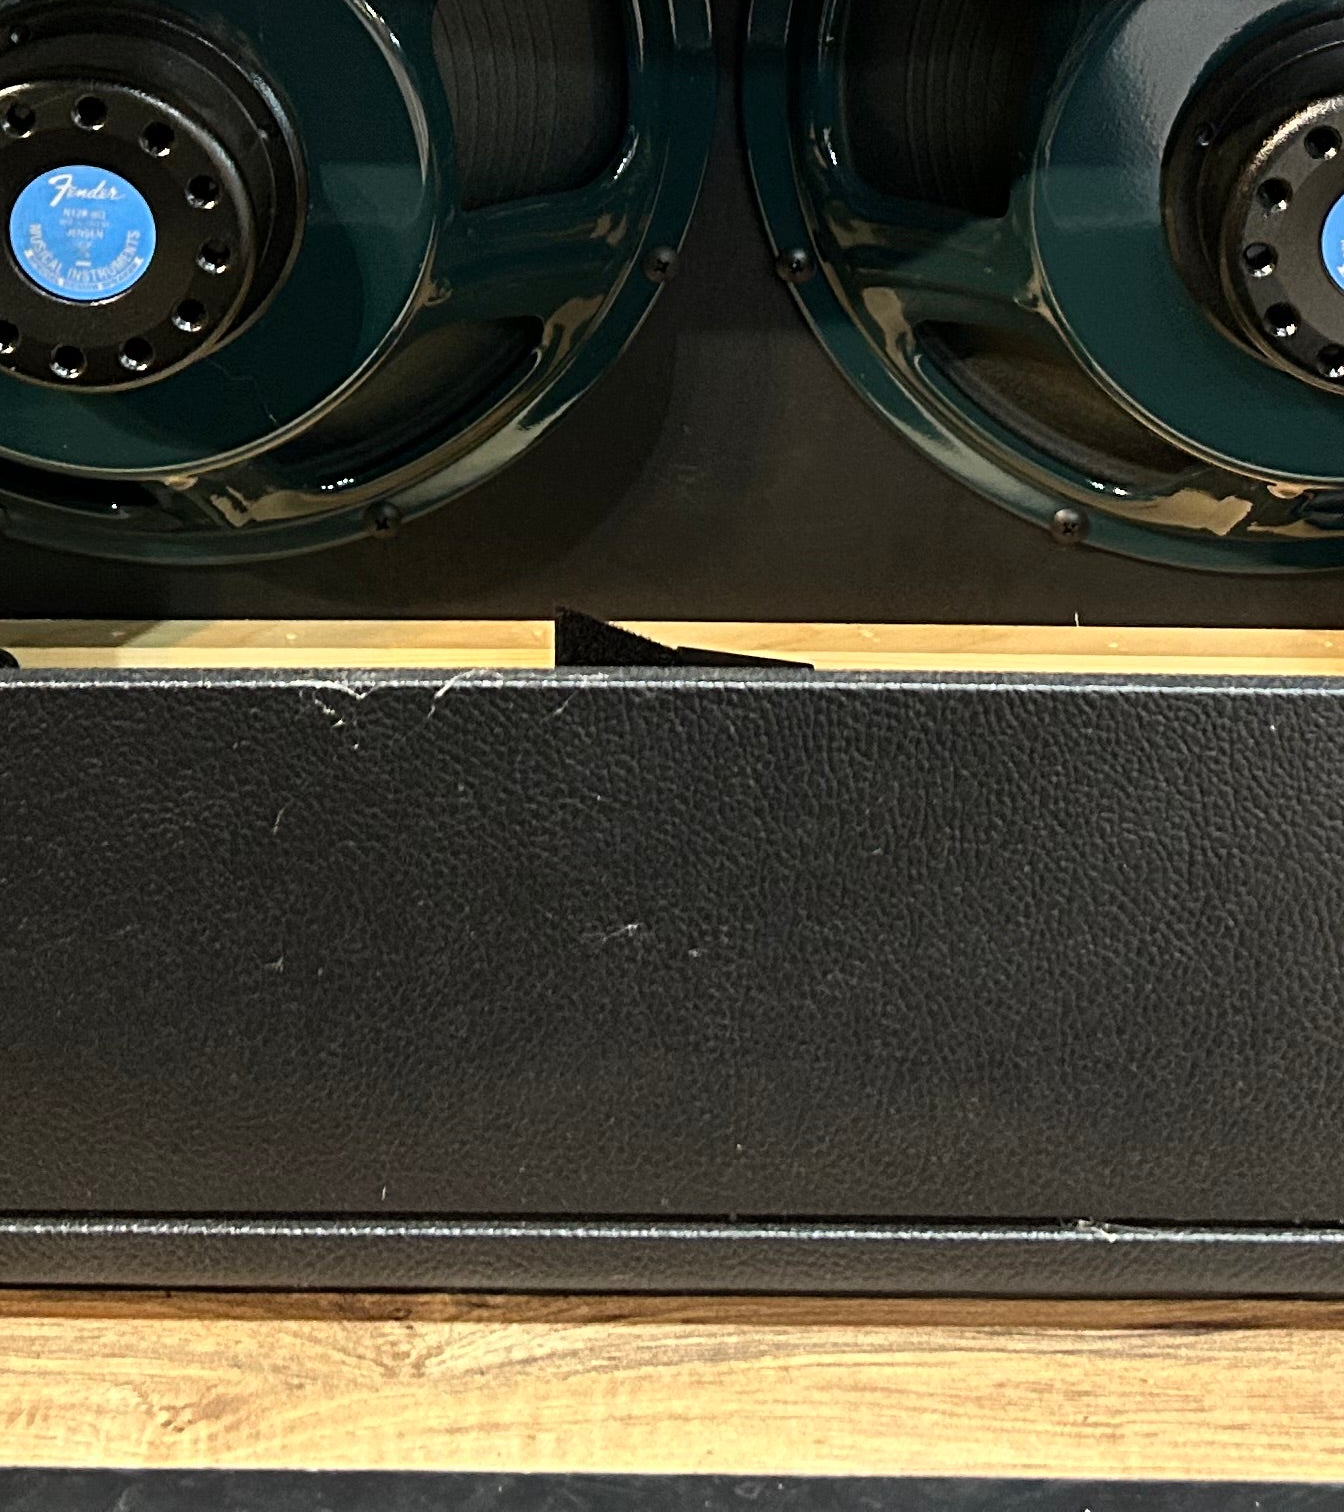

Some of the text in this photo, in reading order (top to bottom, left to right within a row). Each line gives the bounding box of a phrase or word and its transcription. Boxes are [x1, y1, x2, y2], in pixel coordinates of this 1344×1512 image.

[48, 173, 126, 207] Fender
[29, 224, 63, 274] MUSICAL
[67, 229, 142, 282] INSTRUMENTS
